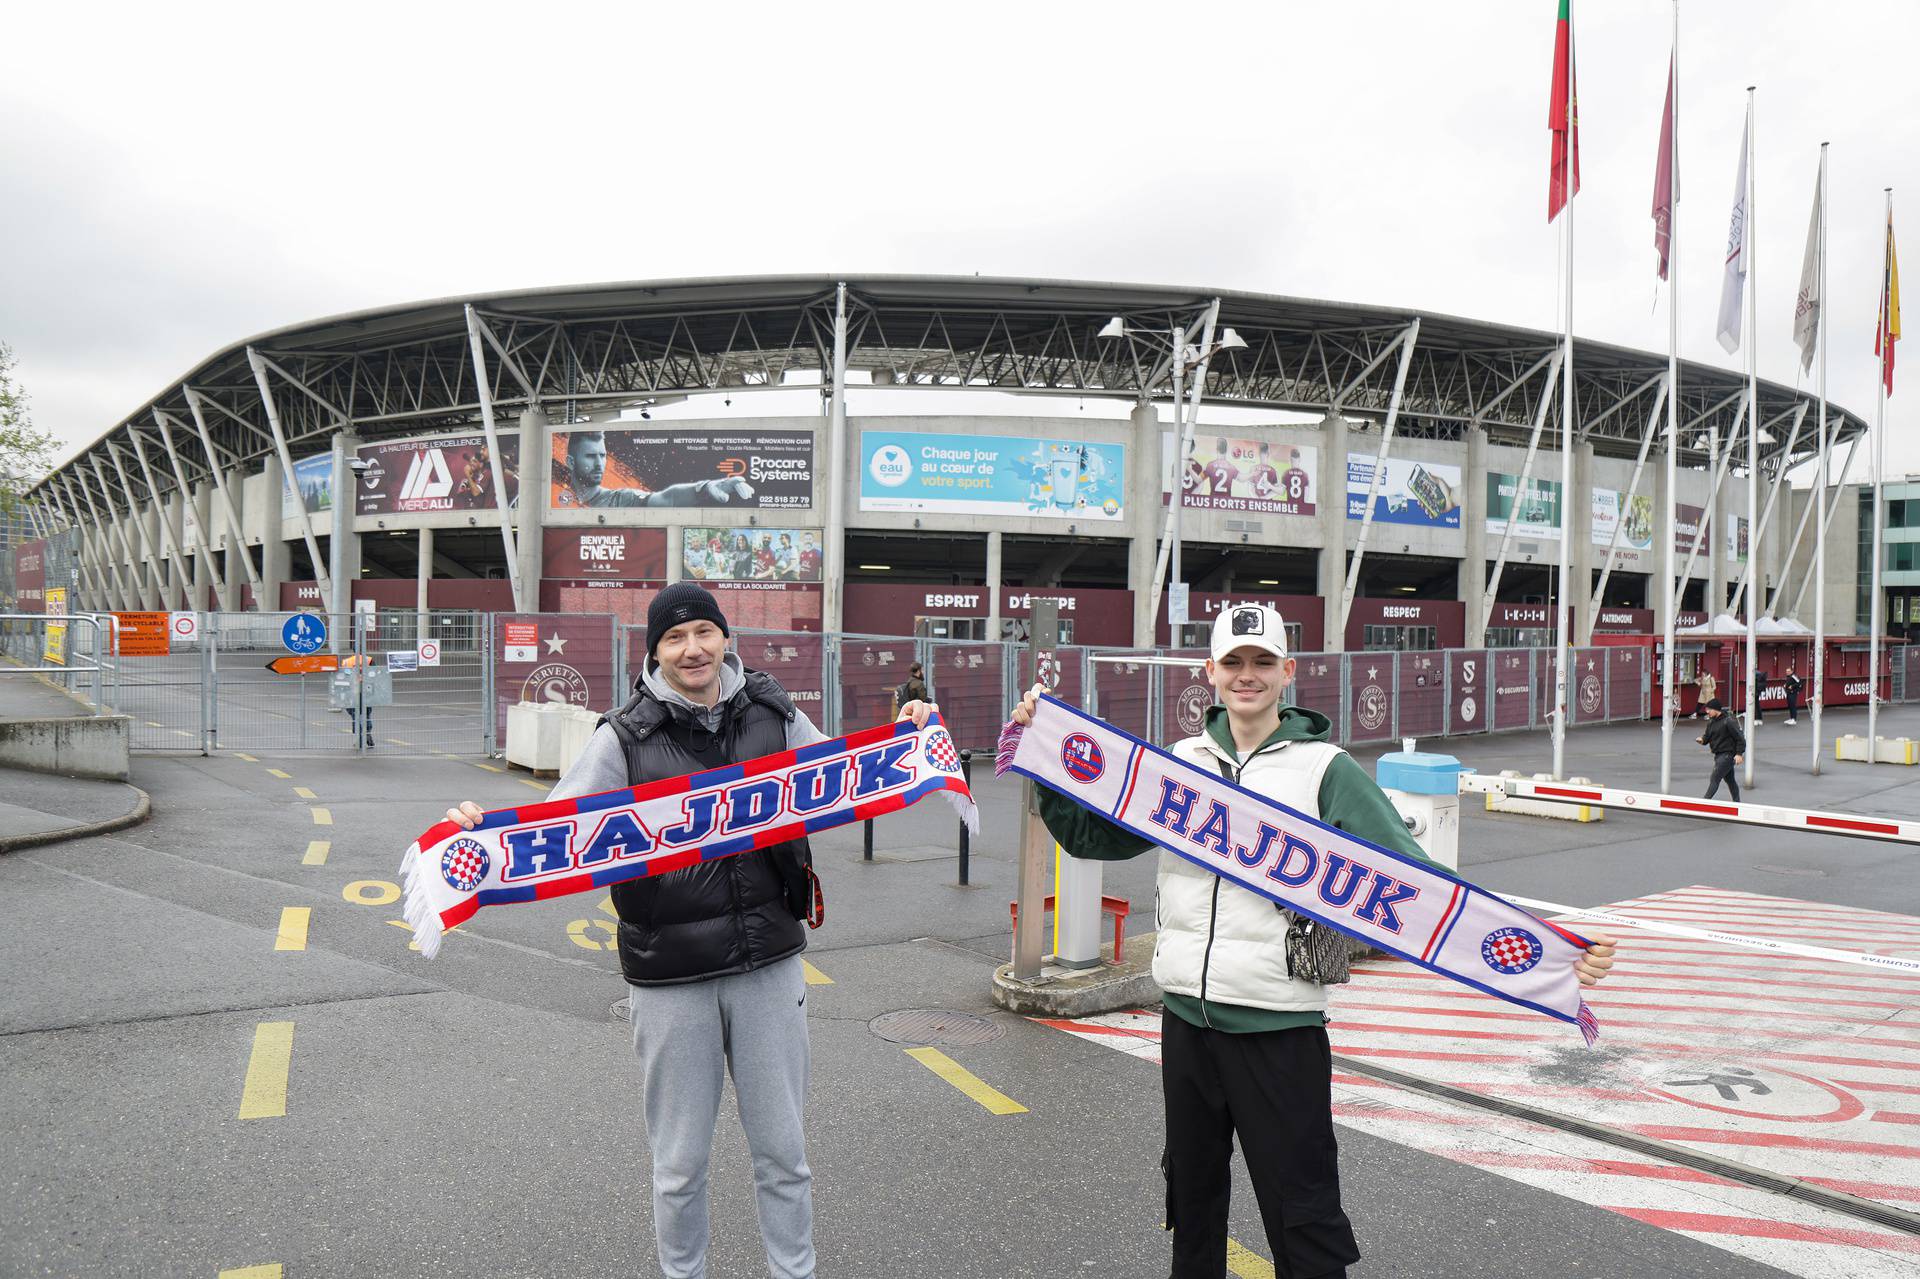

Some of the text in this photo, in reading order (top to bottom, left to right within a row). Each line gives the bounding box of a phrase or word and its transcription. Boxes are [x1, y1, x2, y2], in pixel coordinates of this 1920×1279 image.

[387, 443, 418, 453] HAUTEUR
[419, 442, 429, 450] DE
[429, 438, 482, 449] L'EXCELLENCE
[921, 446, 999, 463] Chaque jour
[1242, 449, 1255, 459] LG
[751, 456, 807, 469] Procare
[879, 463, 903, 473] eau
[921, 462, 994, 475] au cœur de
[750, 467, 811, 483] Systems
[1214, 468, 1228, 493] 2
[921, 476, 993, 489] votre sport.
[1289, 475, 1301, 498] 8
[1184, 496, 1298, 514] PLUS FORTS ENSEMBLE
[619, 534, 625, 544] À
[1623, 552, 1639, 560] NORD
[925, 593, 1076, 610] ESPRIT D'ÉPE
[1383, 606, 1421, 619] RESPECT
[1602, 613, 1632, 624] PATRIMOINE
[531, 667, 581, 687] SERVETTE
[570, 690, 587, 701] FC
[788, 691, 822, 701] RITAS
[1504, 686, 1529, 694] SECURITAS
[934, 758, 959, 772] SPLIT
[503, 738, 916, 881] HAJDUK
[443, 839, 483, 864] HAJDUK
[1149, 775, 1420, 935] HAJDUK
[457, 873, 482, 891] SPLIT
[1483, 928, 1514, 965] HAJDUK
[1707, 933, 1763, 946] SECURITAS
[1513, 942, 1541, 973] SPLIT
